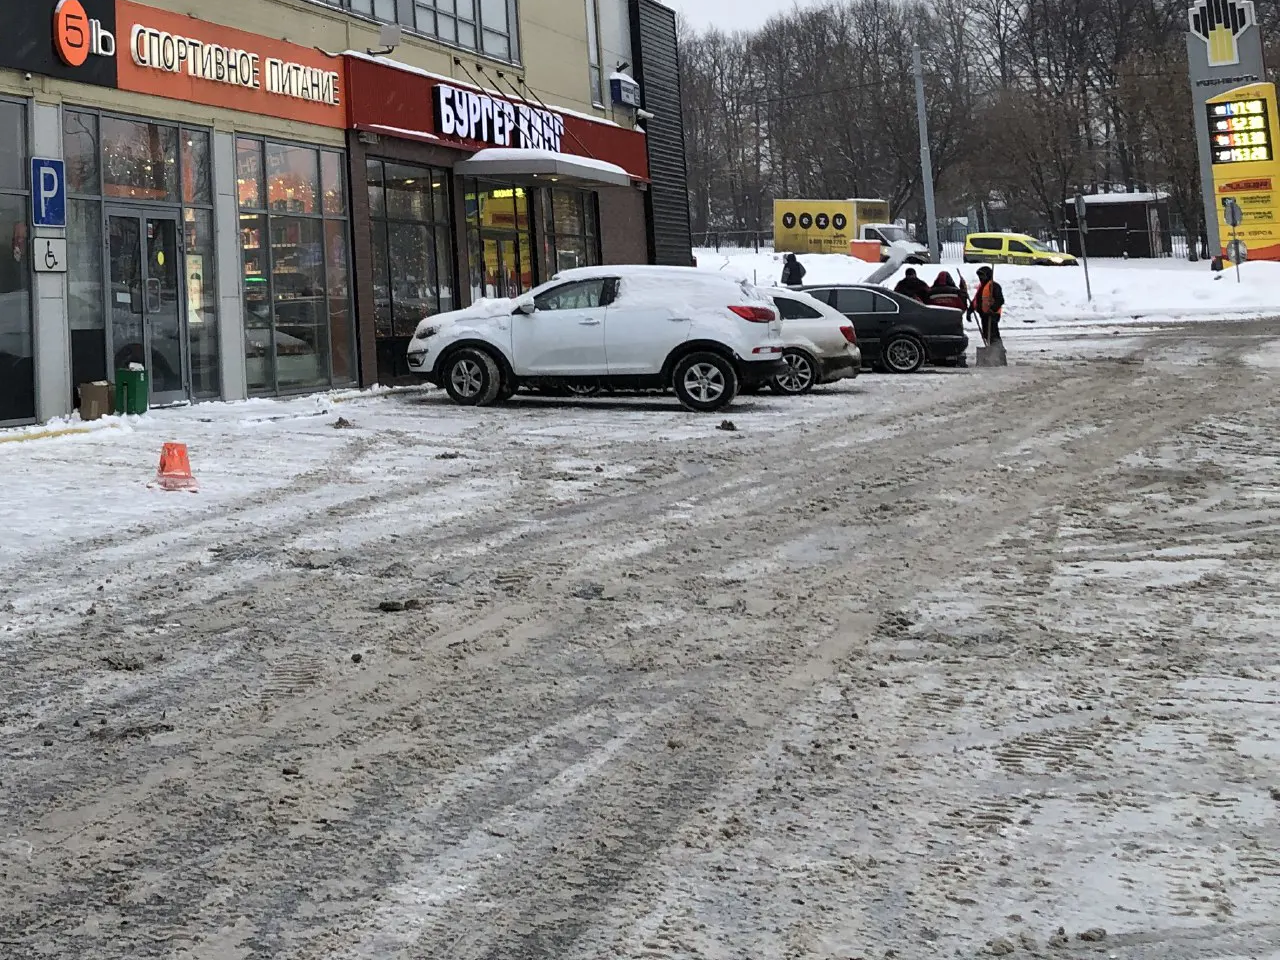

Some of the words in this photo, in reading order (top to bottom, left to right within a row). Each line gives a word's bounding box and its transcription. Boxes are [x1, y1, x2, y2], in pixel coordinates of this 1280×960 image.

[130, 23, 261, 89] СПОРТИВНОЕ
[264, 56, 341, 107] ПИТАНИЕ
[438, 84, 515, 147] БУРГЕР
[518, 103, 565, 153] КИНГ
[40, 167, 59, 218] P
